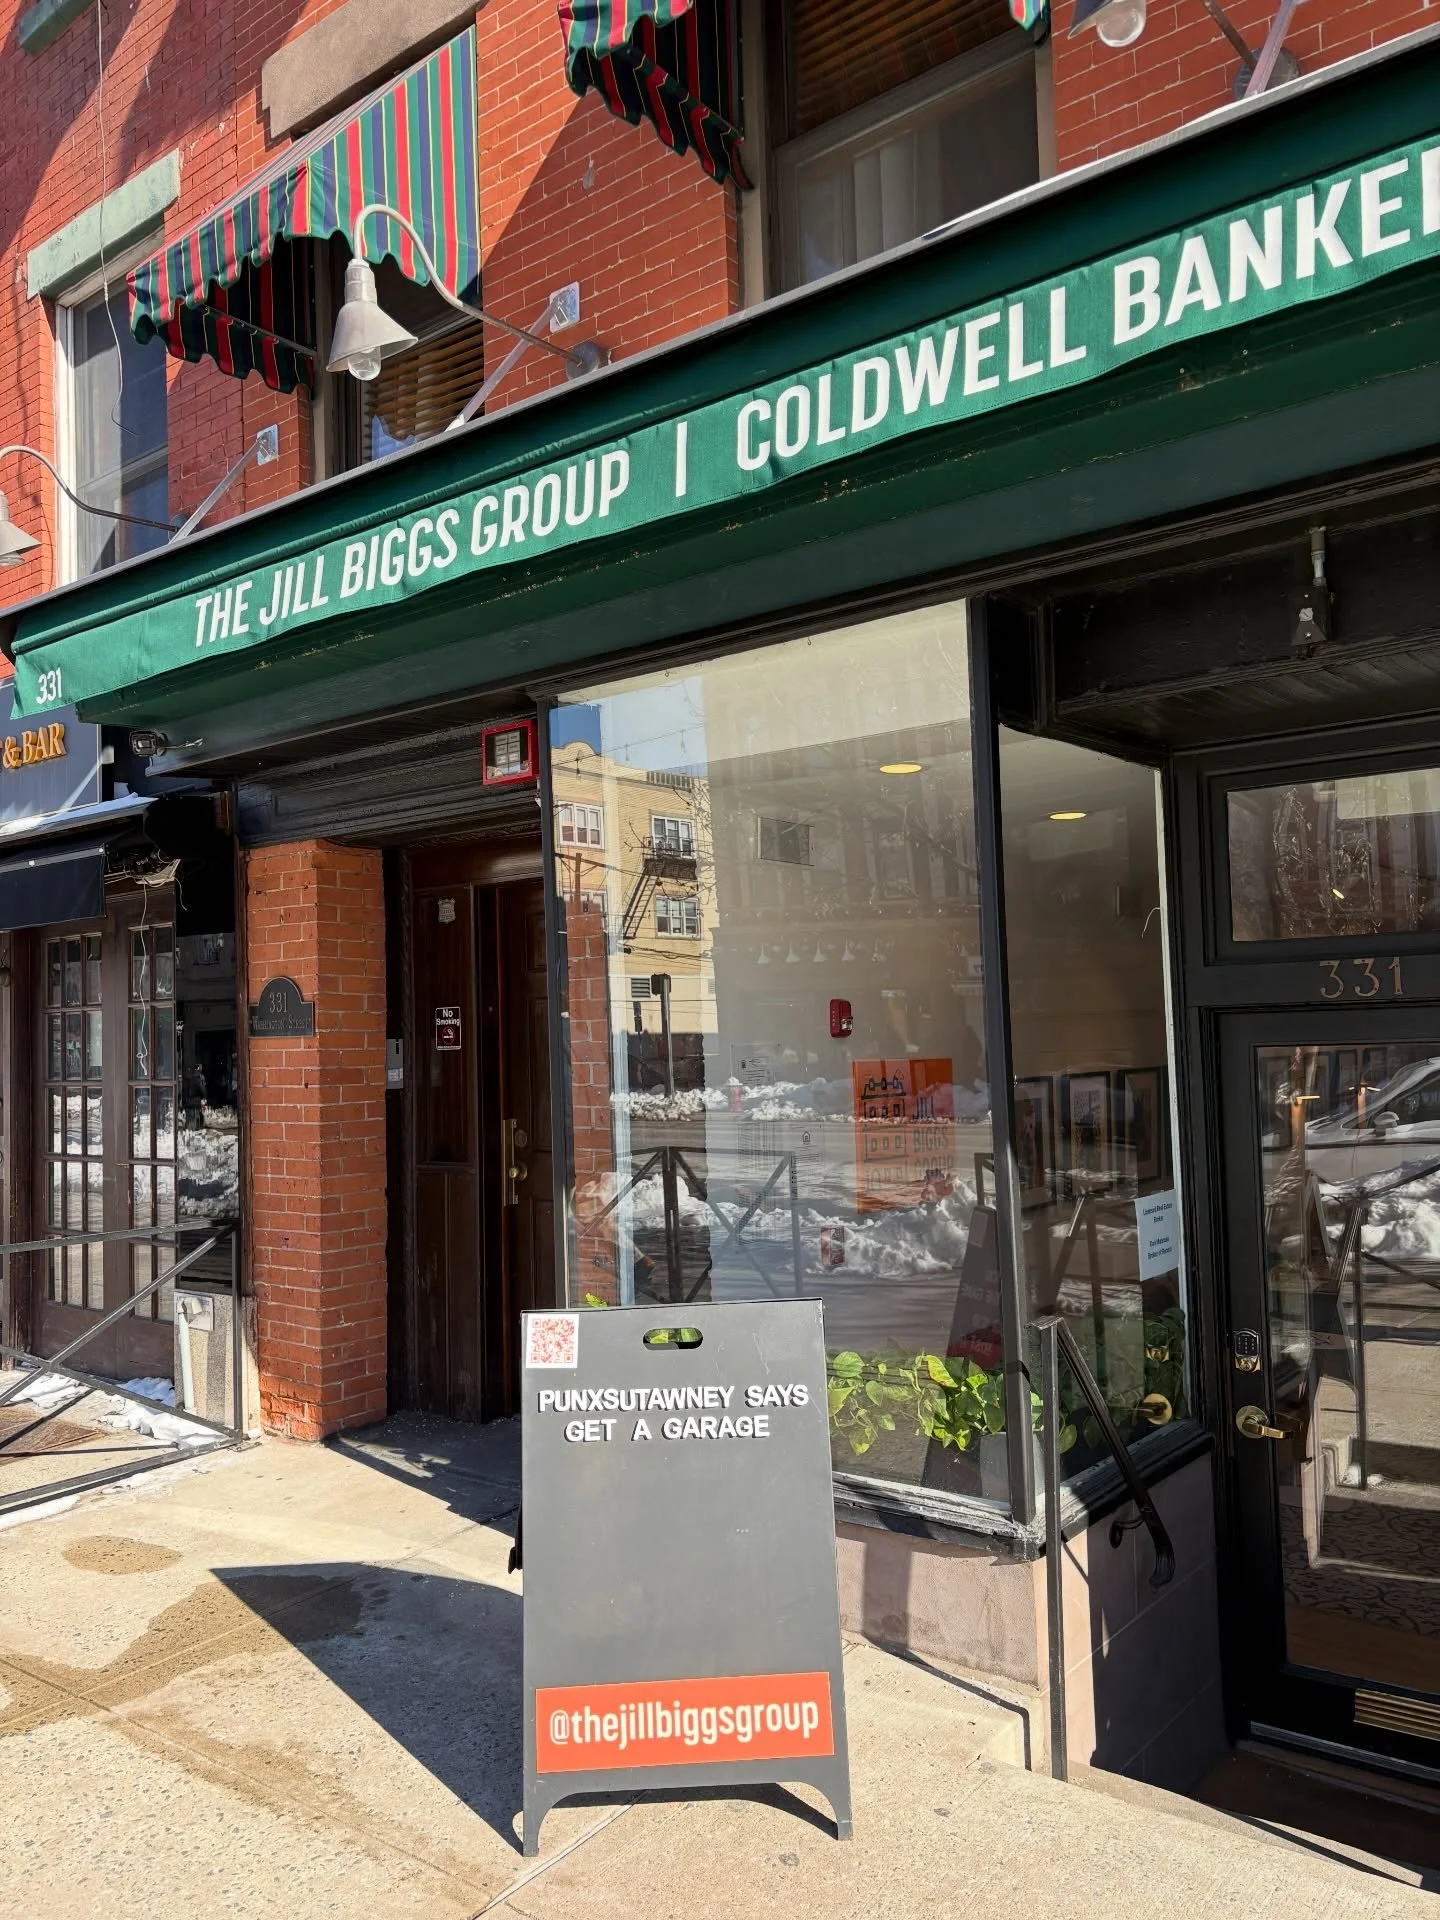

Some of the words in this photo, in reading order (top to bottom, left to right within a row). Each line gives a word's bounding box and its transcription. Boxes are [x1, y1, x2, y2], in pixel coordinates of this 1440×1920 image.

[195, 579, 252, 648] THE
[258, 554, 329, 626] JILL
[339, 508, 460, 599] BIGGS
[470, 449, 630, 557] GROUP
[736, 286, 1087, 472] COLDWELL
[36, 667, 63, 705] 331
[22, 722, 67, 764] BAR
[1319, 956, 1404, 999] 331
[269, 991, 288, 1013] 331
[442, 1008, 454, 1018] No
[436, 1018, 460, 1027] Smoking
[538, 1385, 735, 1413] PUNXSUTAWNEY
[745, 1383, 809, 1408] SAYS
[565, 1418, 617, 1442] GET
[632, 1418, 653, 1442] A
[662, 1414, 771, 1440] GARAGE
[550, 1701, 820, 1750] @thejillbiggsgroup
